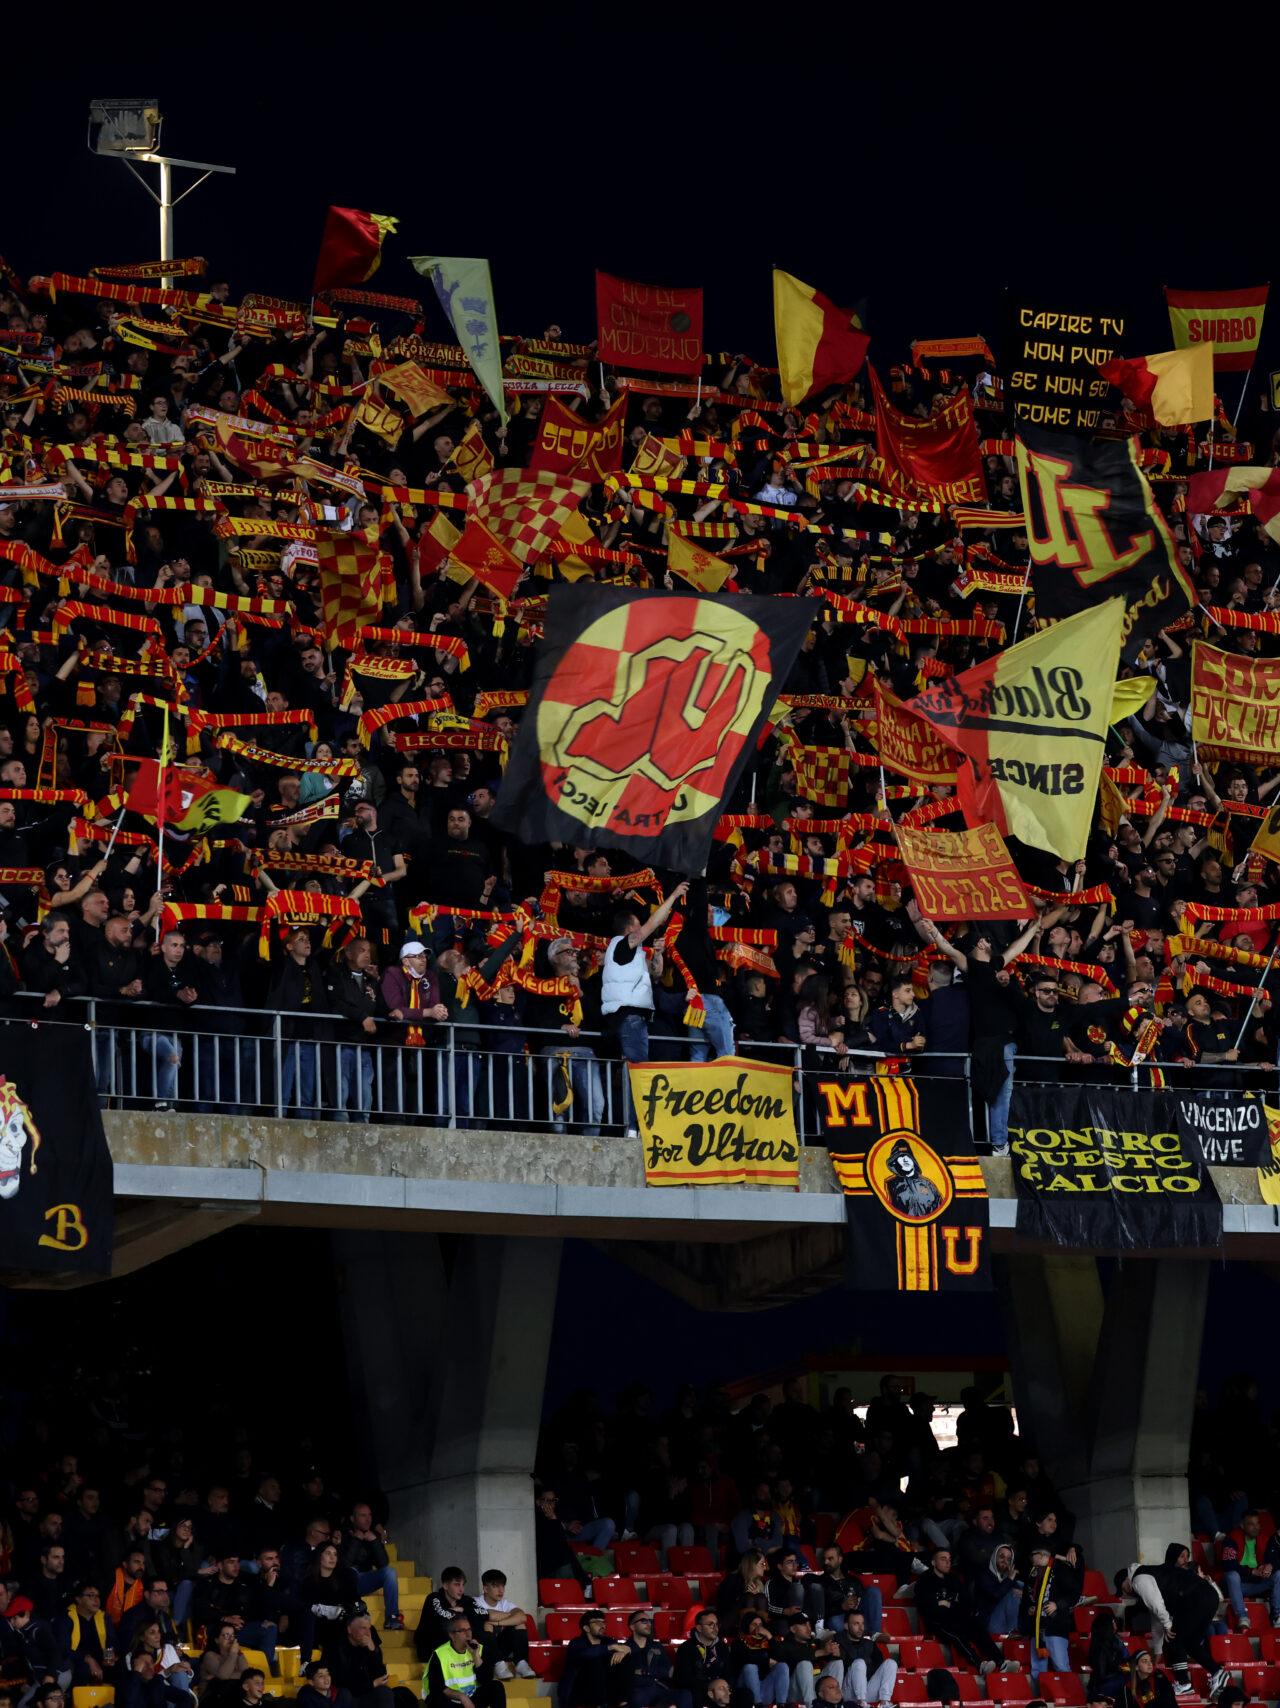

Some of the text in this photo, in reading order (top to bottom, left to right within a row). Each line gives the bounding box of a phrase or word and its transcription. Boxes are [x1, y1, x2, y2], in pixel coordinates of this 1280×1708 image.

[1019, 308, 1092, 335] CAPIRE
[1188, 316, 1256, 343] SURBO
[446, 346, 470, 362] LEC
[600, 326, 701, 361] MODERNO
[1023, 340, 1065, 363] NON
[517, 359, 553, 376] FORZA
[1010, 371, 1038, 388] SE
[1045, 373, 1084, 396] NON
[1016, 402, 1071, 424] COME
[995, 573, 1026, 586] LECCE
[360, 657, 409, 673] LECCE
[404, 734, 477, 748] LECCE
[267, 850, 358, 868] SALENTO
[912, 871, 1027, 915] ULTRAS
[643, 1073, 787, 1129] freedom
[818, 1081, 873, 1127] M
[1180, 1100, 1260, 1133] VINCENZO
[647, 1122, 799, 1169] for Ultras
[1198, 1133, 1245, 1162] VIVE
[38, 1203, 90, 1252] B
[941, 1226, 983, 1275] U
